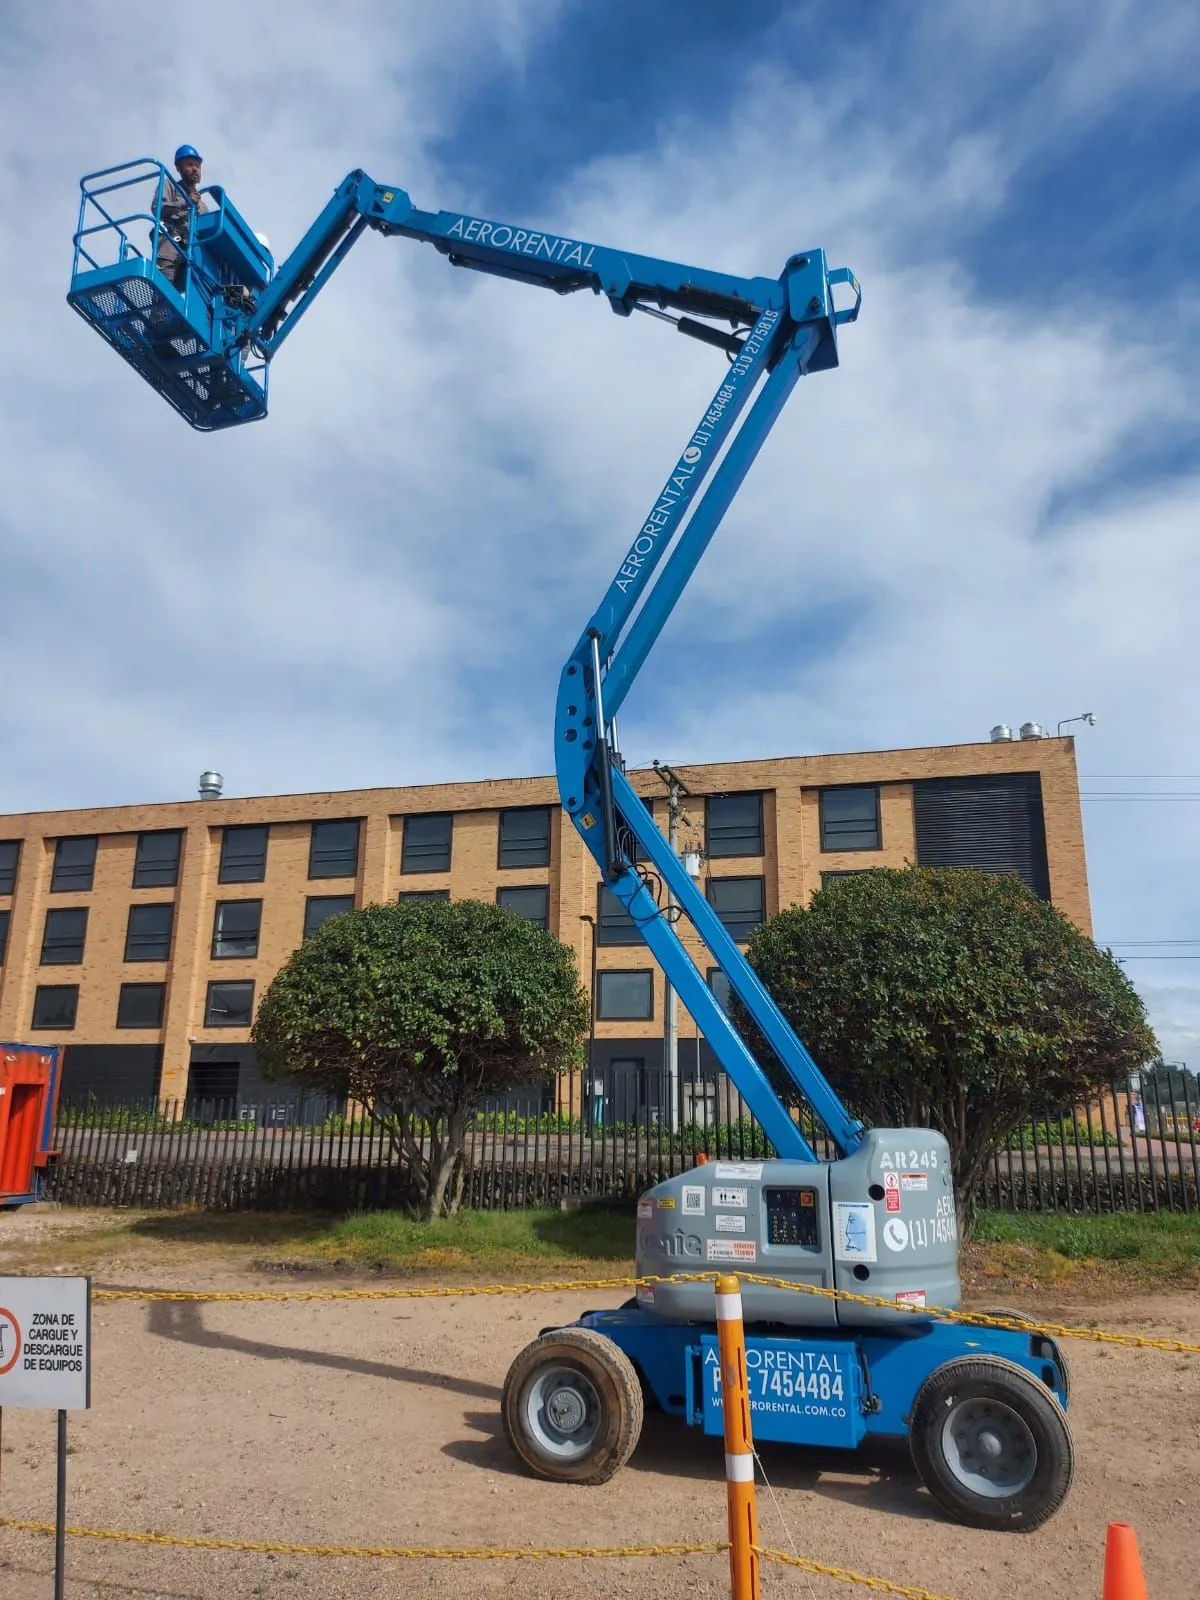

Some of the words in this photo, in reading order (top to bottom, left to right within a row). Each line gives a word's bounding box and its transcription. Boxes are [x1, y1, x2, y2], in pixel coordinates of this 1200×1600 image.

[446, 217, 597, 268] AERORENTAL
[615, 465, 696, 593] AERORENTAL
[692, 430, 711, 446] (1)
[702, 385, 736, 430] 7454484
[733, 355, 753, 376] 310
[879, 1149, 938, 1169] AR245
[909, 1217, 928, 1250] (1)
[32, 1313, 59, 1325] ZONA
[62, 1314, 75, 1326] DE
[29, 1329, 69, 1341] CARGUE
[71, 1329, 79, 1341] Y
[23, 1343, 83, 1357] DESCARGUE
[704, 1347, 843, 1373] AORENTAL
[24, 1358, 37, 1370] DE
[39, 1359, 82, 1372] EQUIPOS
[758, 1369, 844, 1401] 7454484
